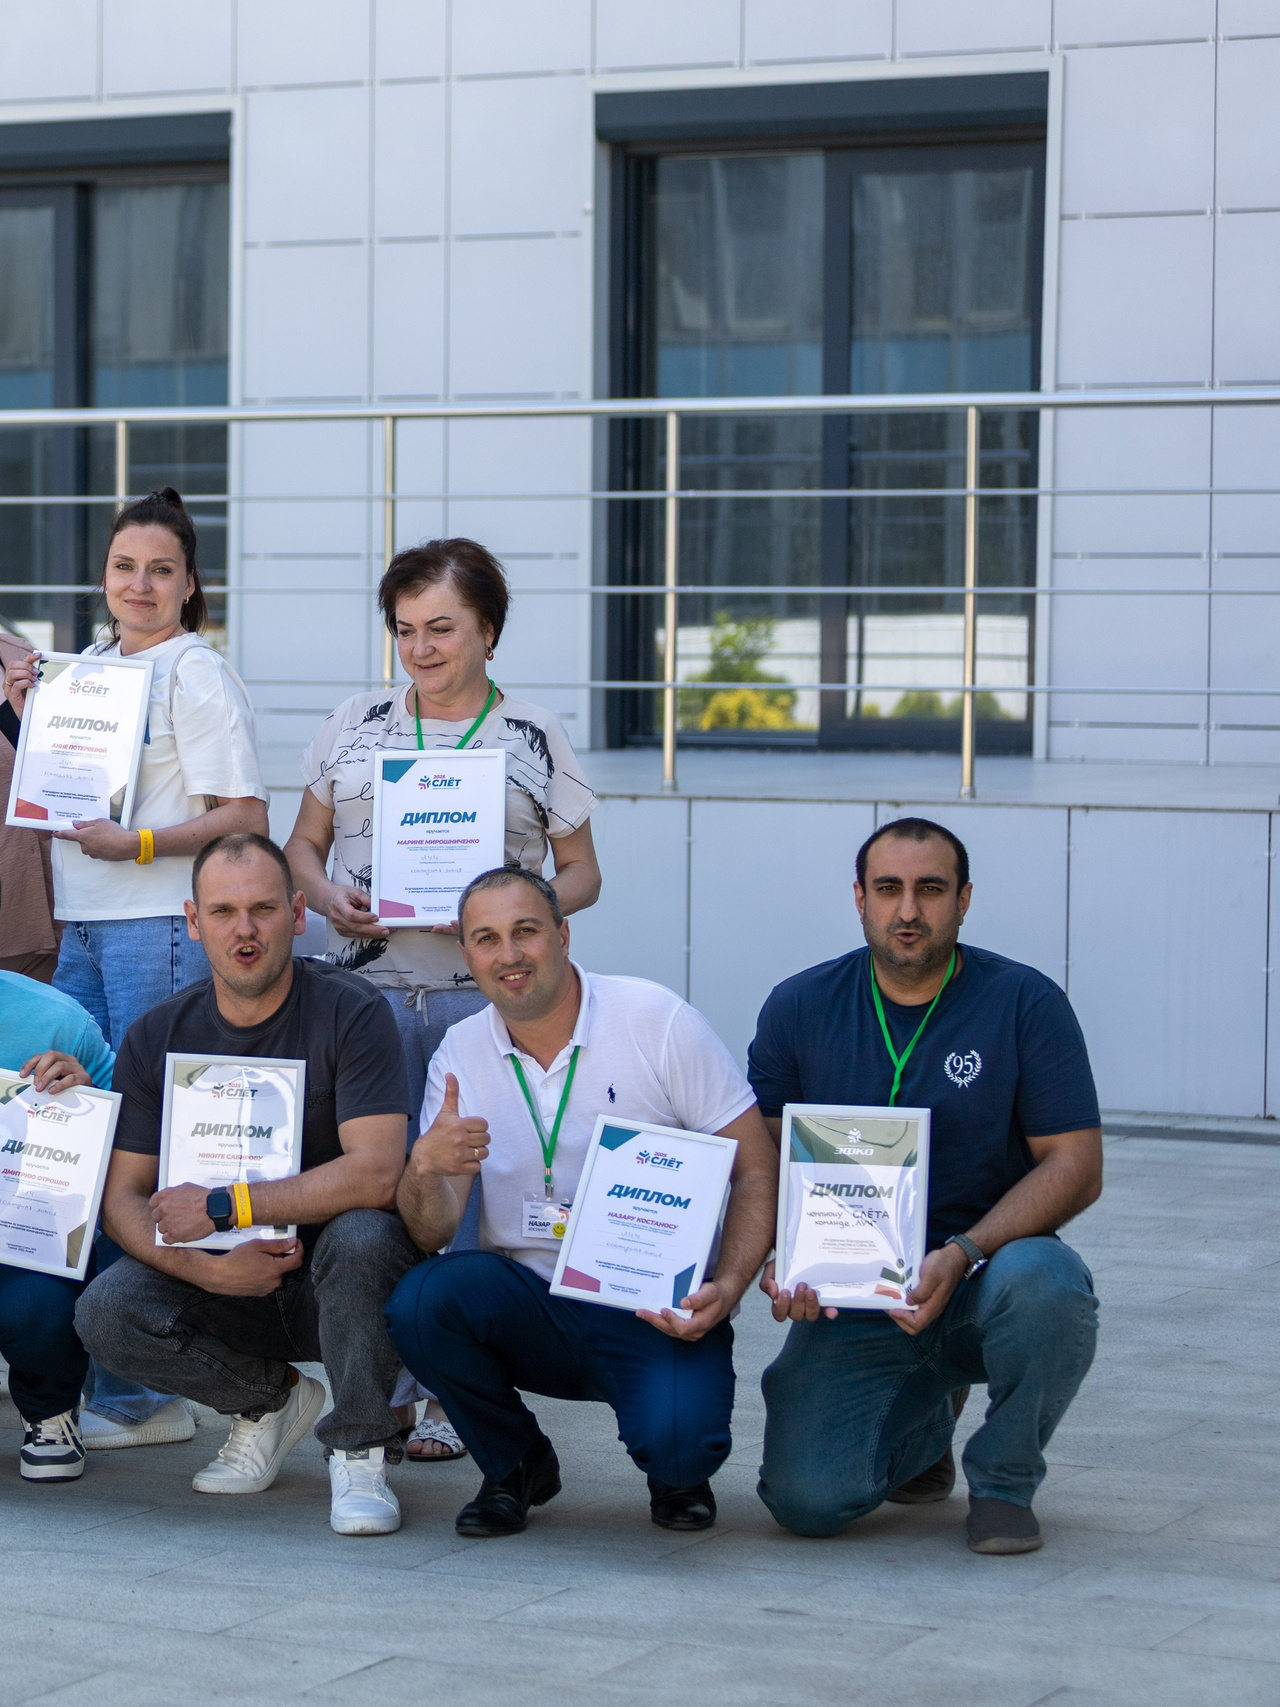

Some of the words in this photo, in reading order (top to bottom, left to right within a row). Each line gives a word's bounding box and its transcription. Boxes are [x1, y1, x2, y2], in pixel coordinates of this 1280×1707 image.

[82, 685, 109, 695] СЛЁТ
[47, 716, 119, 733] ДИПЛОМ
[432, 777, 462, 787] СЛЁТ
[400, 812, 477, 826] ДИПЛОМ
[953, 1056, 973, 1074] 95
[226, 1086, 258, 1098] СЛЁТ
[41, 1110, 72, 1124] СЛЁТ
[191, 1122, 273, 1139] ДИПЛОМ
[1, 1139, 81, 1166] ДИПЛОМ
[833, 1147, 874, 1156] ЭФКО
[651, 1156, 684, 1169] СЛЁТ
[2, 1168, 36, 1180] ДМИТРИЮ
[37, 1175, 70, 1187] ОТРОШКО
[607, 1183, 691, 1210] ДИПЛОМ
[809, 1182, 894, 1198] ДИПЛОМ
[633, 1206, 657, 1214] вручается
[852, 1207, 890, 1219] СЛЁТА
[607, 1211, 636, 1221] НАЗАРУ
[637, 1217, 679, 1230] КОСТАНОСУ
